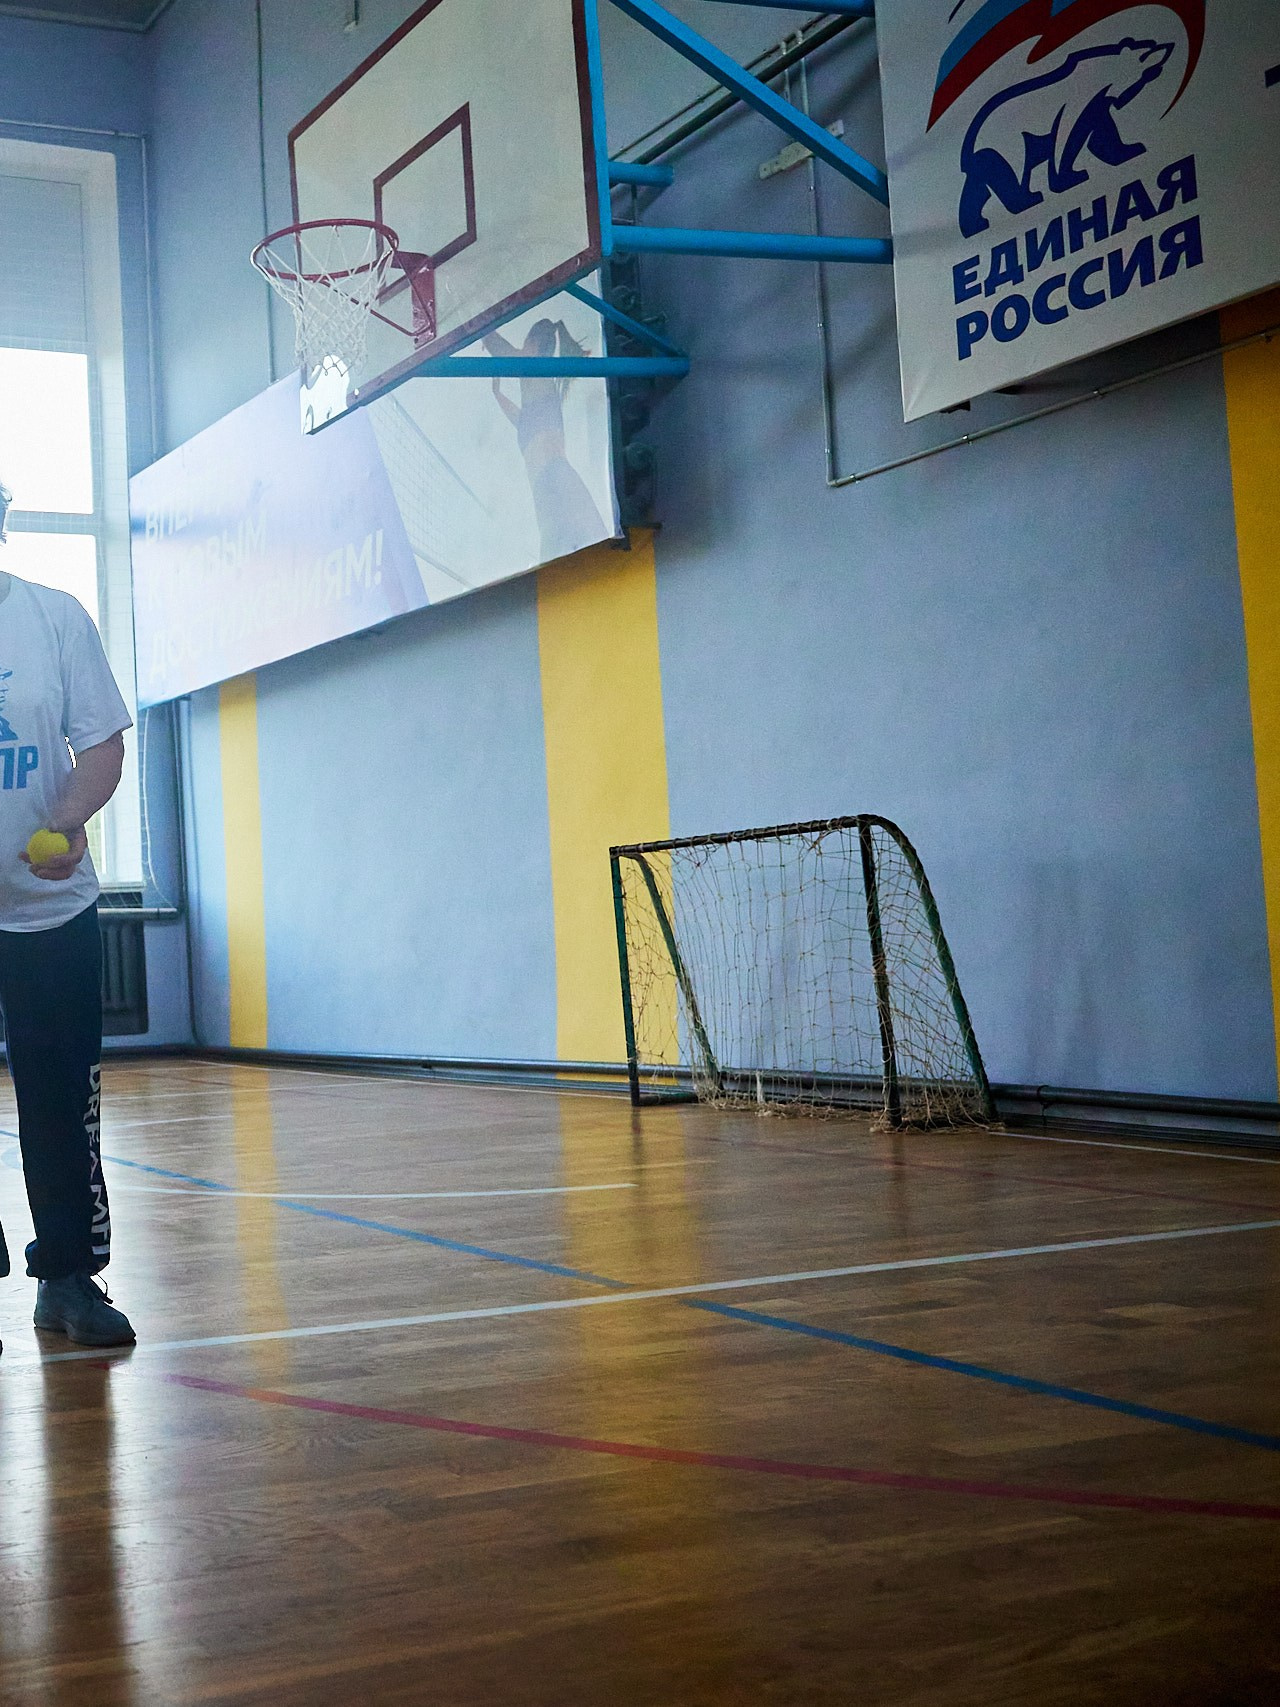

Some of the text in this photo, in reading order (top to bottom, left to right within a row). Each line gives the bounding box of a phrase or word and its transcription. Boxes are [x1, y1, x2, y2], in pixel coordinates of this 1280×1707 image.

[952, 154, 1199, 305] ЕДИНАЯ
[956, 215, 1204, 361] РОССИЯ
[169, 508, 267, 600] ОВЫМ
